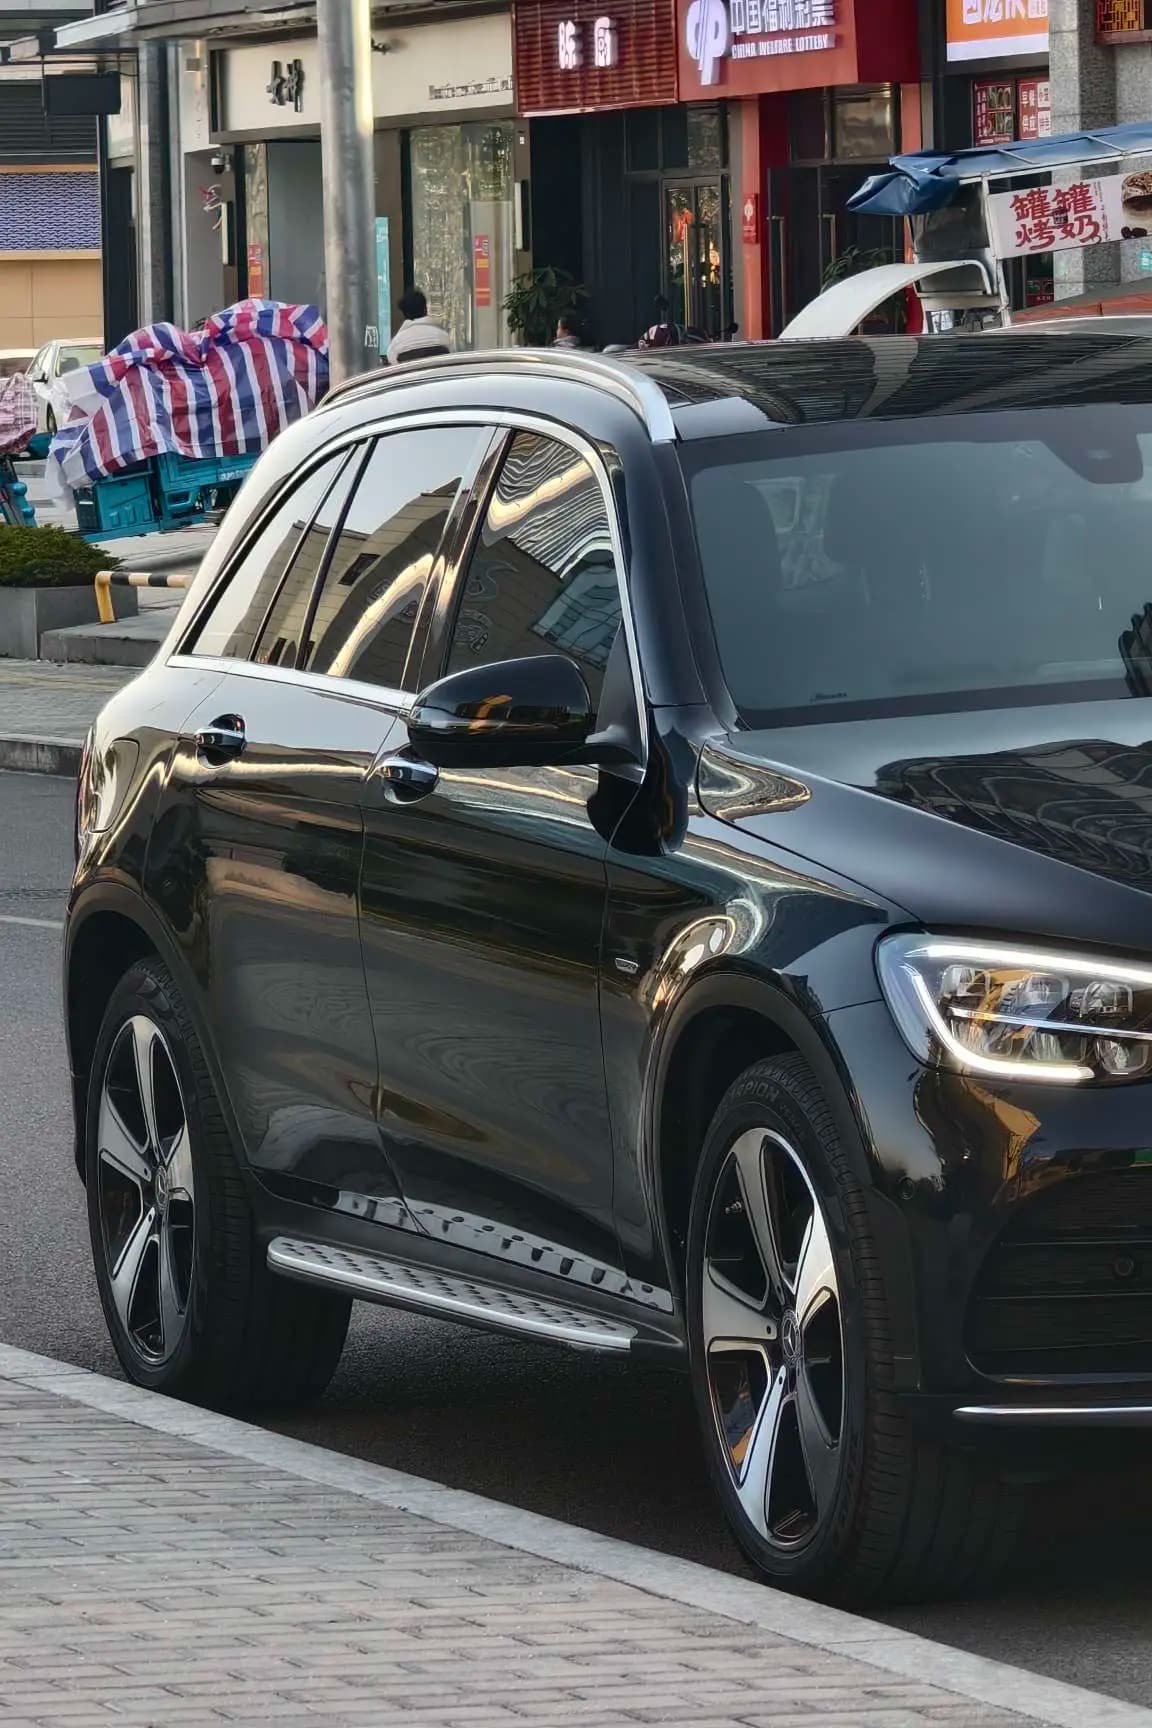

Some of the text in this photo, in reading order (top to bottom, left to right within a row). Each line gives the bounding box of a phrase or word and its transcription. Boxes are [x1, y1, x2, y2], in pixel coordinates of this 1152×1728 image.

[732, 34, 829, 59] CHINA WELFARE LOTTERY
[1015, 215, 1100, 250] 烤奶
